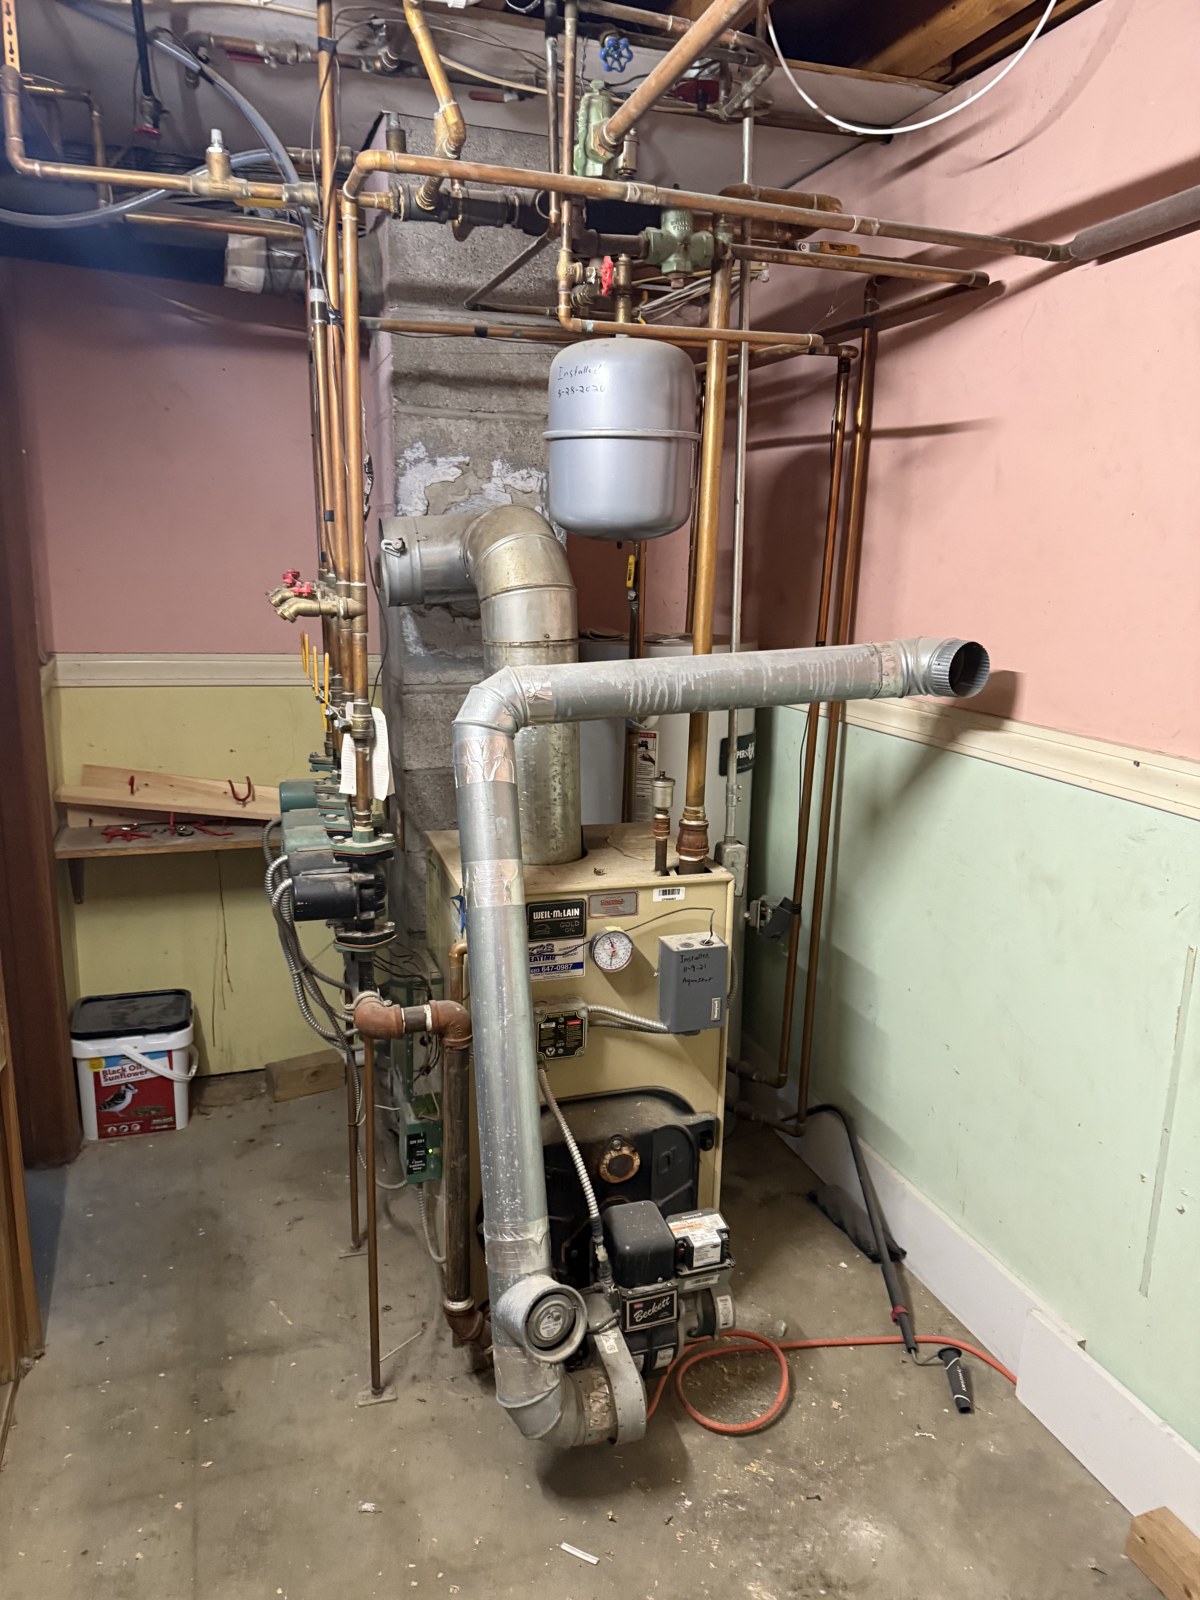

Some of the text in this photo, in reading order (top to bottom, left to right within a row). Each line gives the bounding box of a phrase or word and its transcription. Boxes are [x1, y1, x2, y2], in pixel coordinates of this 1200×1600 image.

[560, 920, 580, 928] GOLD
[541, 963, 573, 972] 647-0987
[102, 1066, 127, 1076] Black
[103, 1069, 148, 1082] Sunflower
[633, 1296, 671, 1322] Beckett
